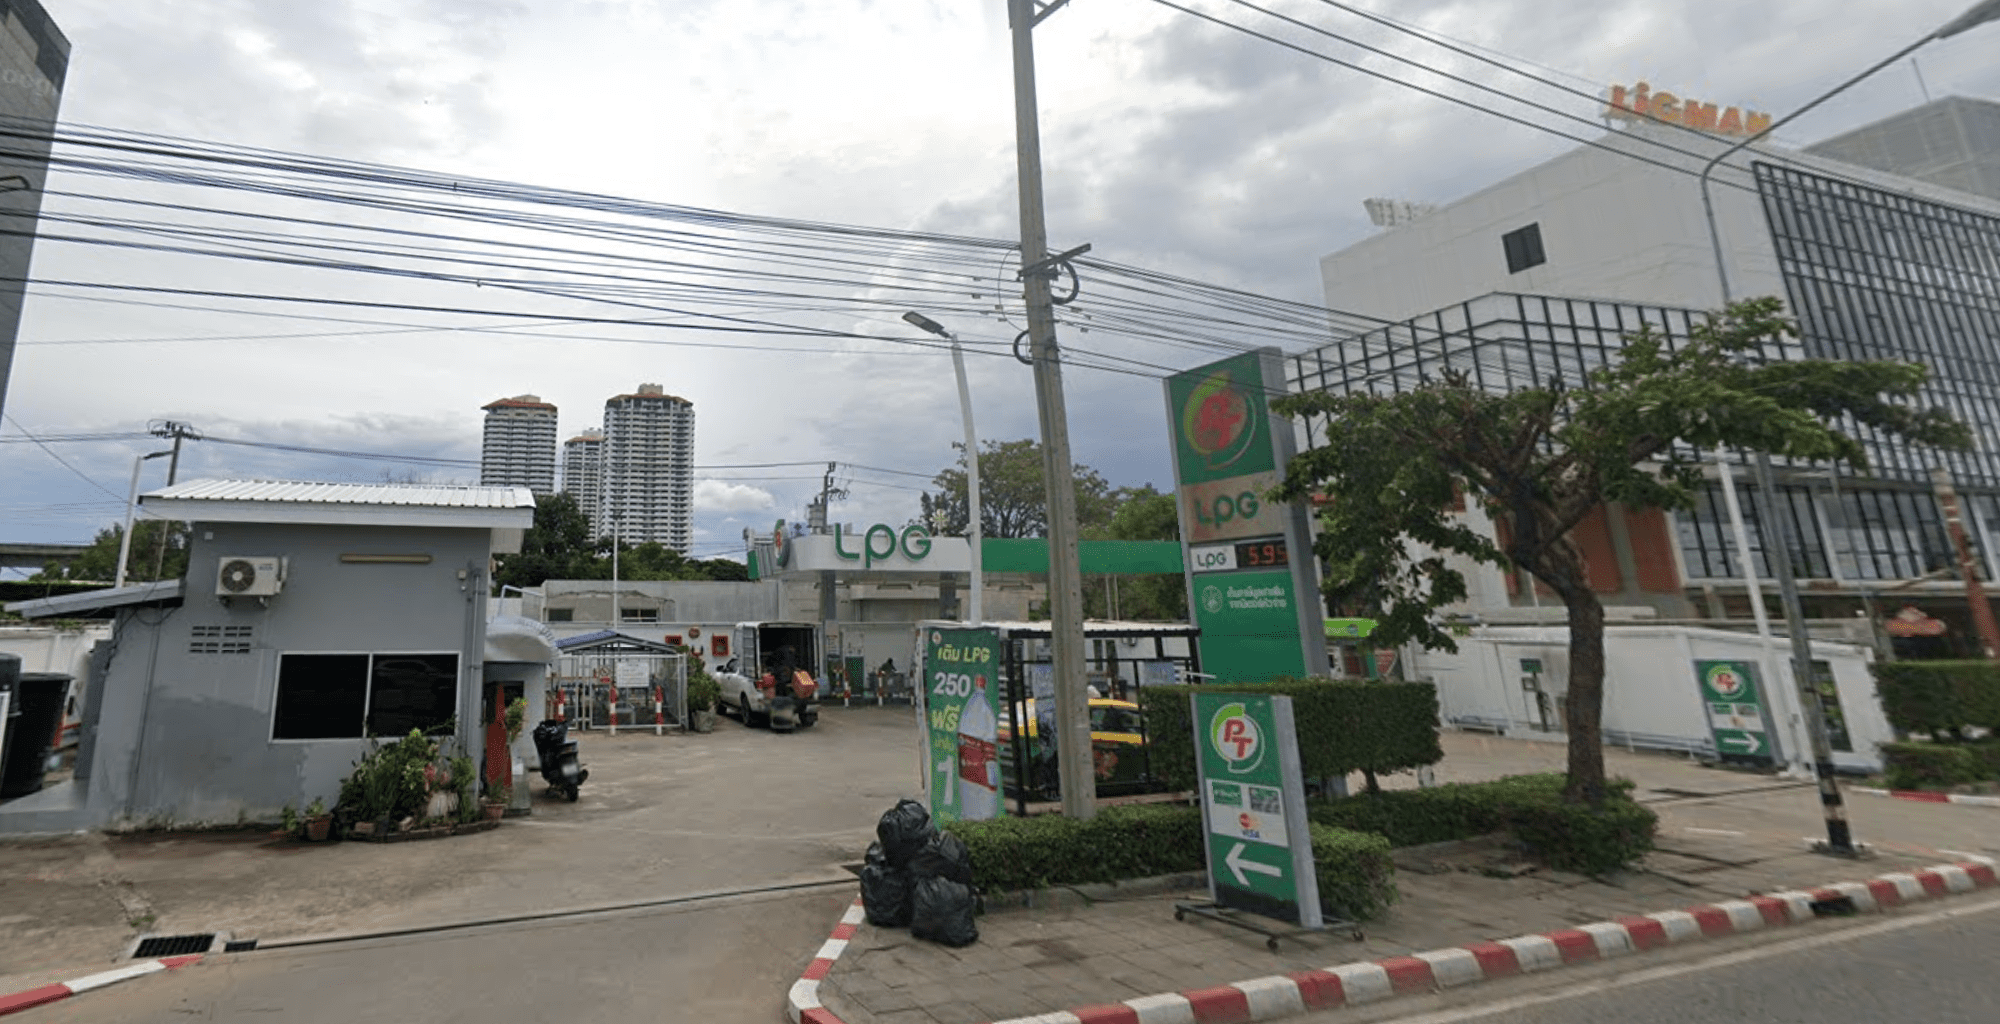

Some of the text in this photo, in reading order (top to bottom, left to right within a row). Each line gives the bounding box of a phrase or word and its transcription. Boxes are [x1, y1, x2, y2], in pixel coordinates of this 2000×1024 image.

[963, 646, 991, 664] LPG
[933, 672, 971, 698] 250
[931, 705, 960, 732] ฟรี
[1224, 719, 1253, 758] PT
[937, 755, 954, 805] 1
